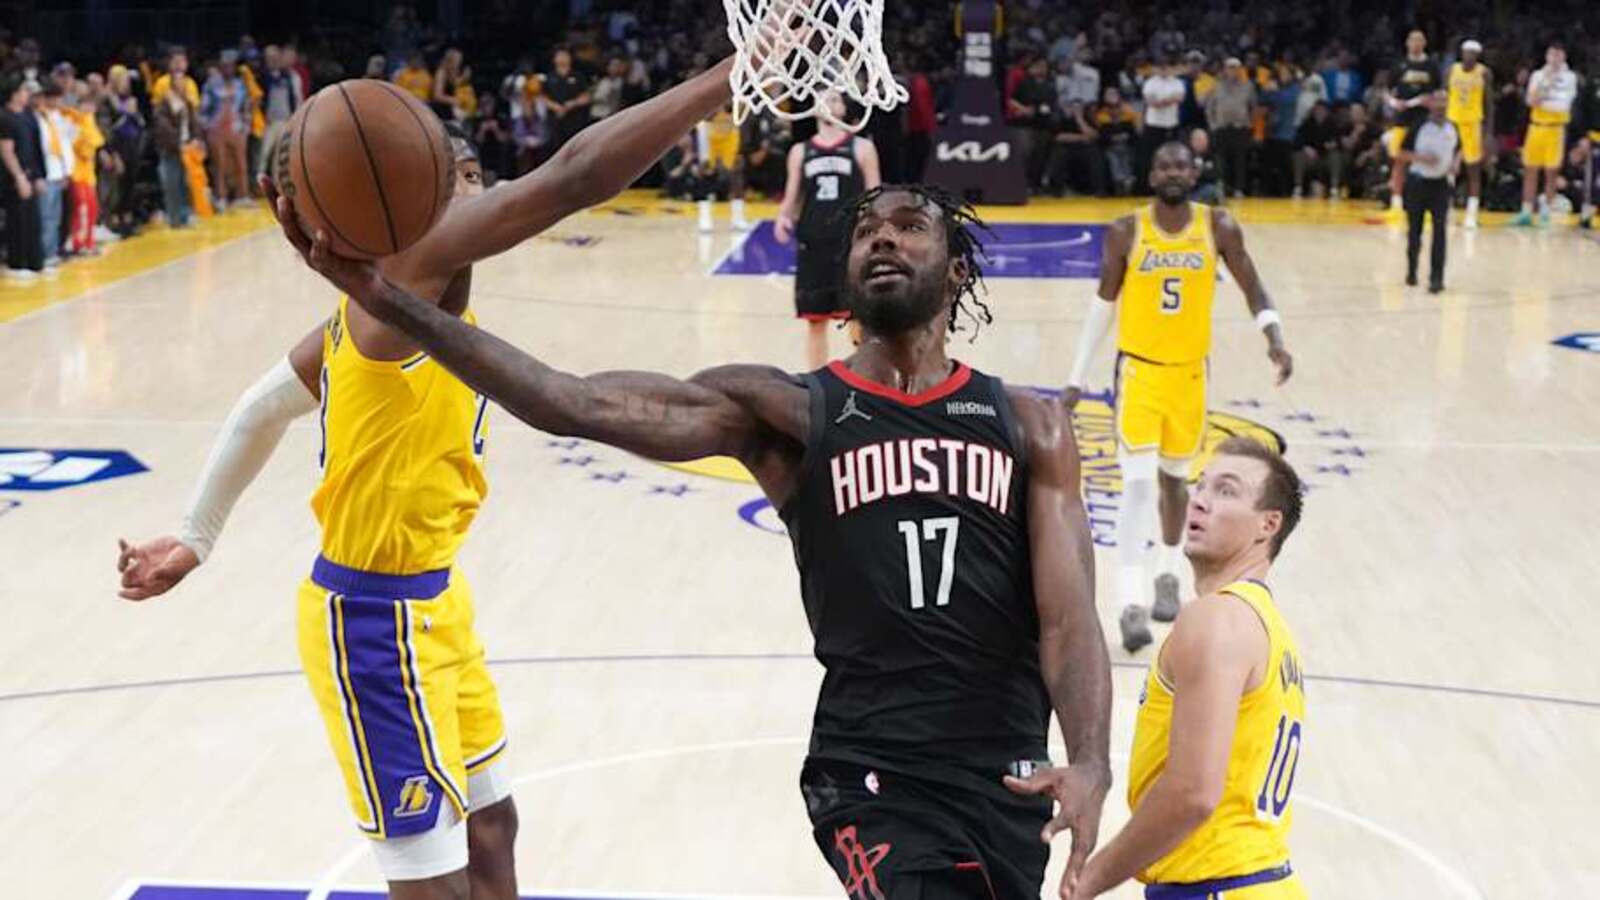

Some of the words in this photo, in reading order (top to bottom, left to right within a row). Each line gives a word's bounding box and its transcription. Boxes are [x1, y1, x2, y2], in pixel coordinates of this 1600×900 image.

[816, 175, 839, 200] 28
[1137, 249, 1205, 273] LAKERS
[1161, 278, 1182, 312] 5
[829, 437, 1014, 517] HOUSTON
[897, 515, 960, 609] 17
[1256, 712, 1301, 818] 10
